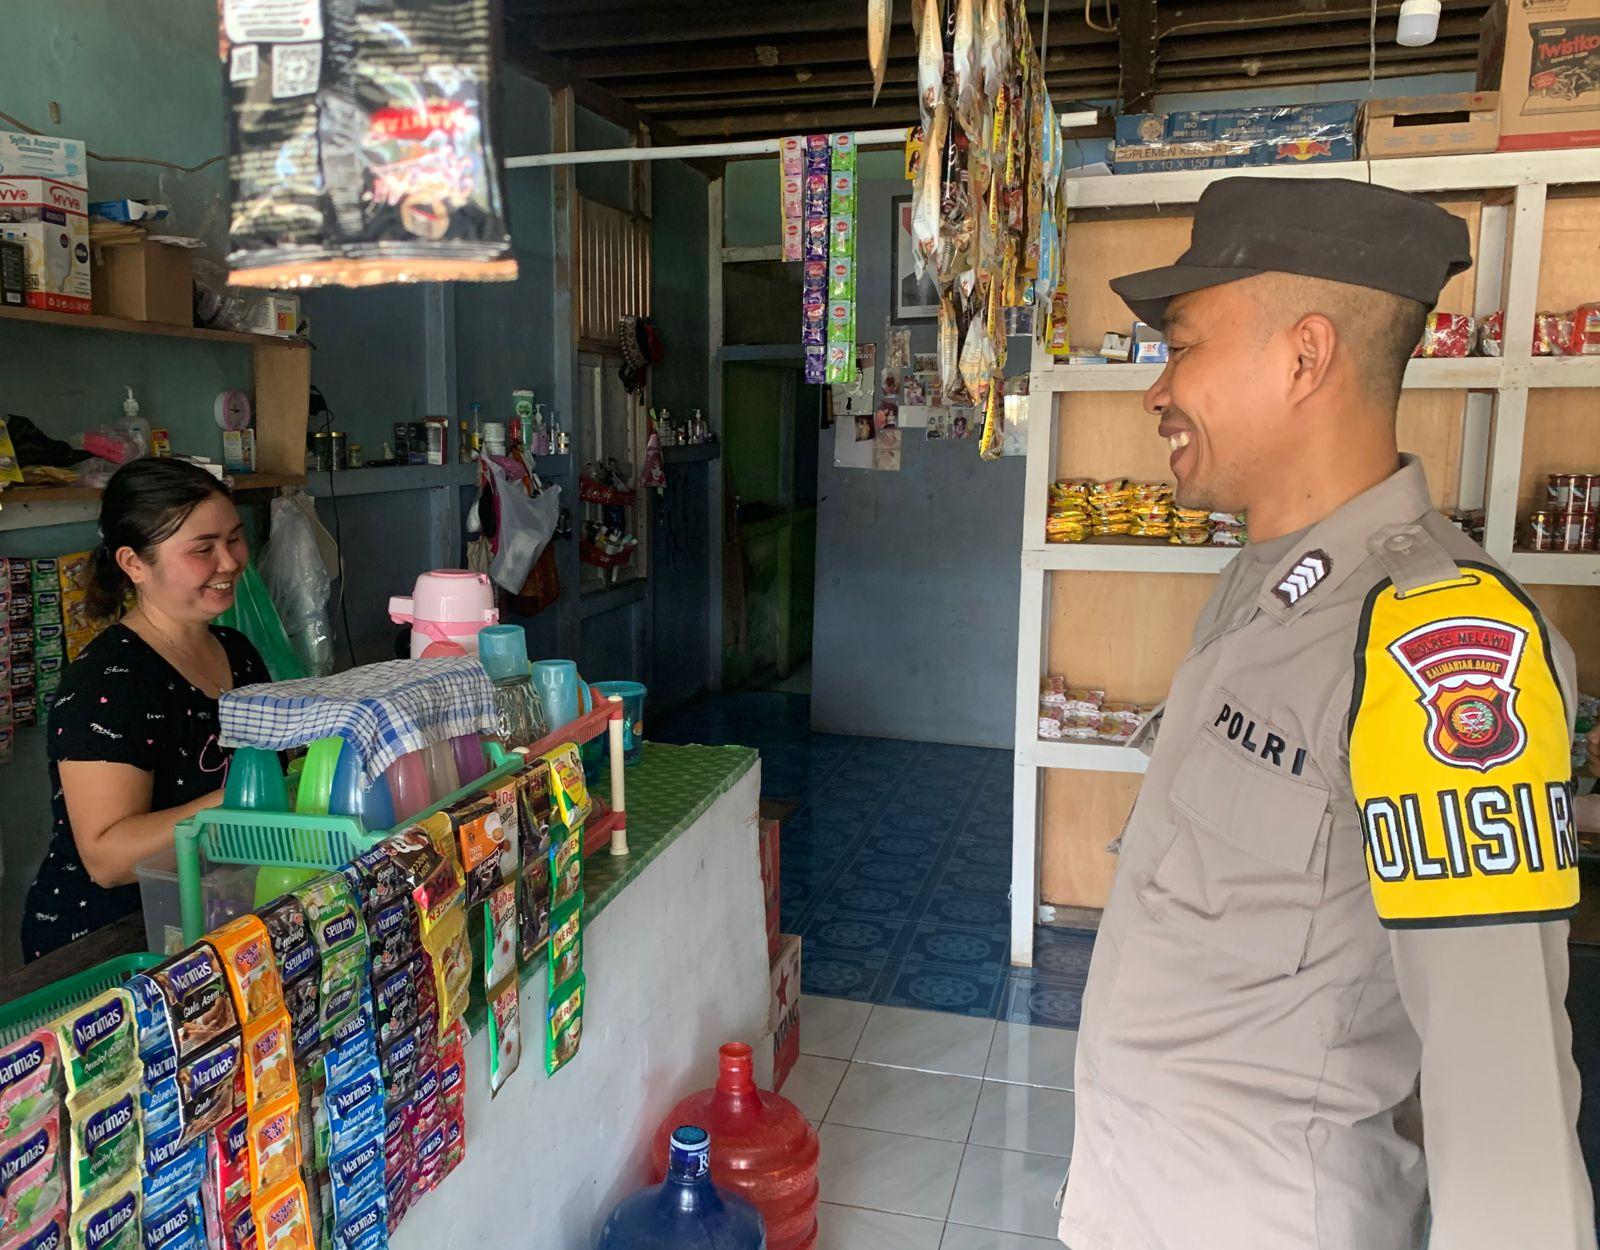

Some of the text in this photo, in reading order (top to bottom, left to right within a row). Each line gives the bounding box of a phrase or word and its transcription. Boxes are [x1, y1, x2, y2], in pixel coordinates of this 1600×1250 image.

[1213, 703, 1307, 777] POLRI
[1356, 779, 1579, 883] OLISI R
[325, 915, 356, 938] Marimas
[171, 960, 212, 992] Marimas
[75, 1008, 122, 1045] Marimas
[192, 1055, 234, 1089] Marimas
[338, 1081, 372, 1109] Marimas
[87, 1106, 130, 1144] Marimas
[0, 1139, 45, 1182] Marimas
[150, 1158, 196, 1193] Blueberry
[342, 1146, 376, 1176] Marimas
[89, 1203, 132, 1245] Marimas
[147, 1210, 189, 1248] Marimas
[344, 1209, 378, 1240] Marimas
